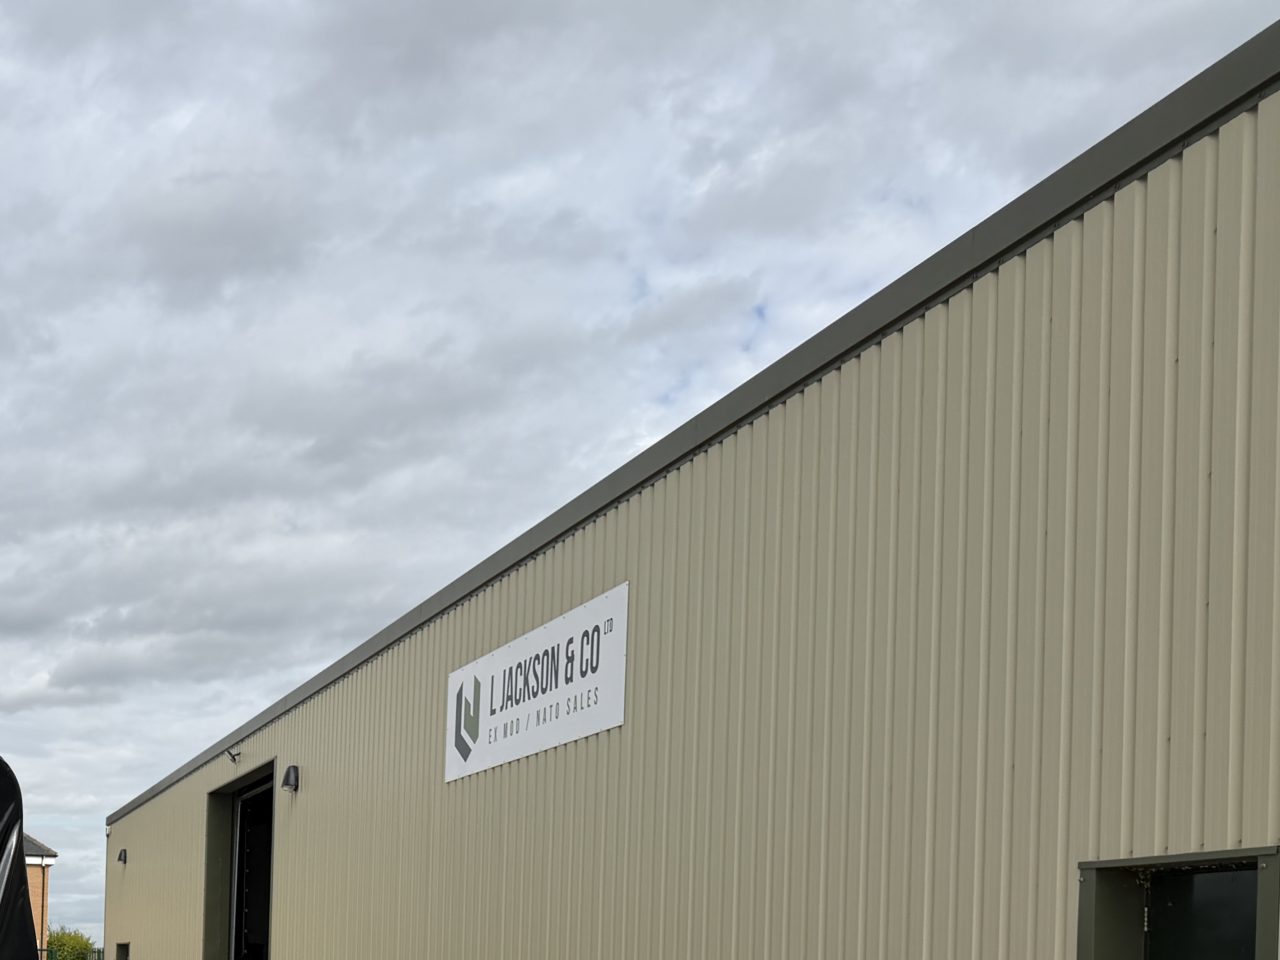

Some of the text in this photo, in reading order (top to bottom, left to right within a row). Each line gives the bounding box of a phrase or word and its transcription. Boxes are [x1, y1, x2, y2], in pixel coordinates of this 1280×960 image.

[489, 618, 614, 717] L JACKSON & CO LTD
[488, 686, 599, 744] EX MOD / NATO SALES
